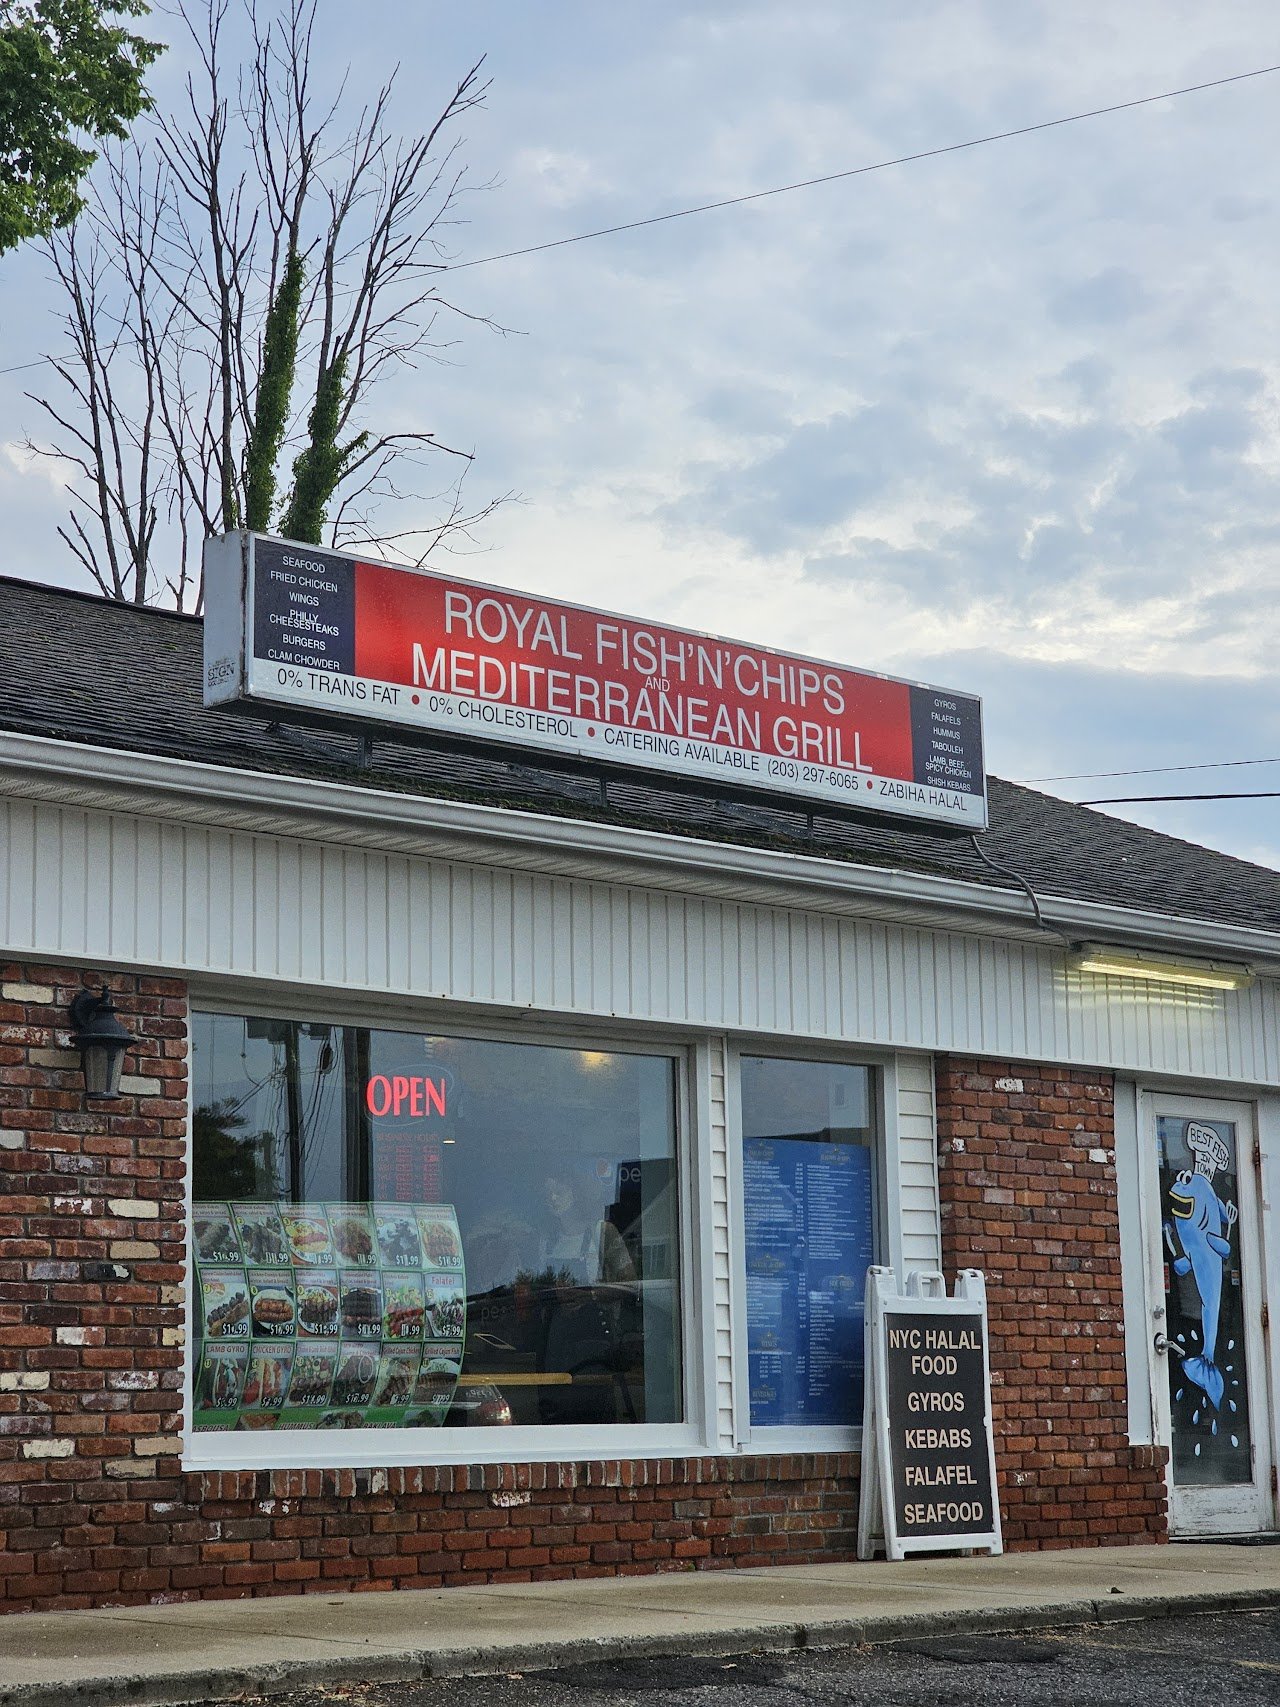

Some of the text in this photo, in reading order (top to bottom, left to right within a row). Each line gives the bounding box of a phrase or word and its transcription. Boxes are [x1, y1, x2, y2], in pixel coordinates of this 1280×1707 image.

[282, 555, 326, 574] SEAFOOD
[270, 570, 338, 593] FRIED CHICKEN
[289, 591, 319, 606] WINGS
[269, 613, 339, 636] CHEESESTEAKS
[289, 609, 319, 623] PHILLY
[282, 633, 326, 651] BURGERS
[268, 648, 340, 671] CLAM CHOWDER
[444, 590, 845, 715] ROYAL FISH'N'CHIPS
[645, 675, 670, 692] AND
[412, 642, 873, 773] MEDITERRANEAN GRILL
[934, 698, 957, 711] GYROS
[931, 711, 961, 726] FALAFELS
[277, 668, 968, 811] 0% TRANS FAT 0% CHOLESTEROL CATERING AVAILABLE (203) 297-6065 ZABIHA HALAL
[933, 726, 960, 740] HUMMUS
[931, 740, 964, 755] TABOULEH
[925, 761, 972, 779] SPICY CHICKEN
[927, 775, 971, 792] SHISH KEBABS
[366, 1074, 446, 1117] OPEN
[1190, 1127, 1229, 1168] BEST FISH
[1200, 1153, 1210, 1163] IN
[1196, 1161, 1214, 1179] TOWN
[206, 1345, 245, 1353] LAMB GYRO
[889, 1329, 981, 1350] NYC HALAL
[253, 1345, 277, 1354] CHICKEN
[277, 1346, 292, 1354] GYRO
[911, 1355, 958, 1375] FOOD
[907, 1392, 965, 1412] GYROS
[905, 1428, 972, 1449] KEBABS
[905, 1465, 977, 1486] FALAFEL
[904, 1501, 984, 1525] SEAFOOD
